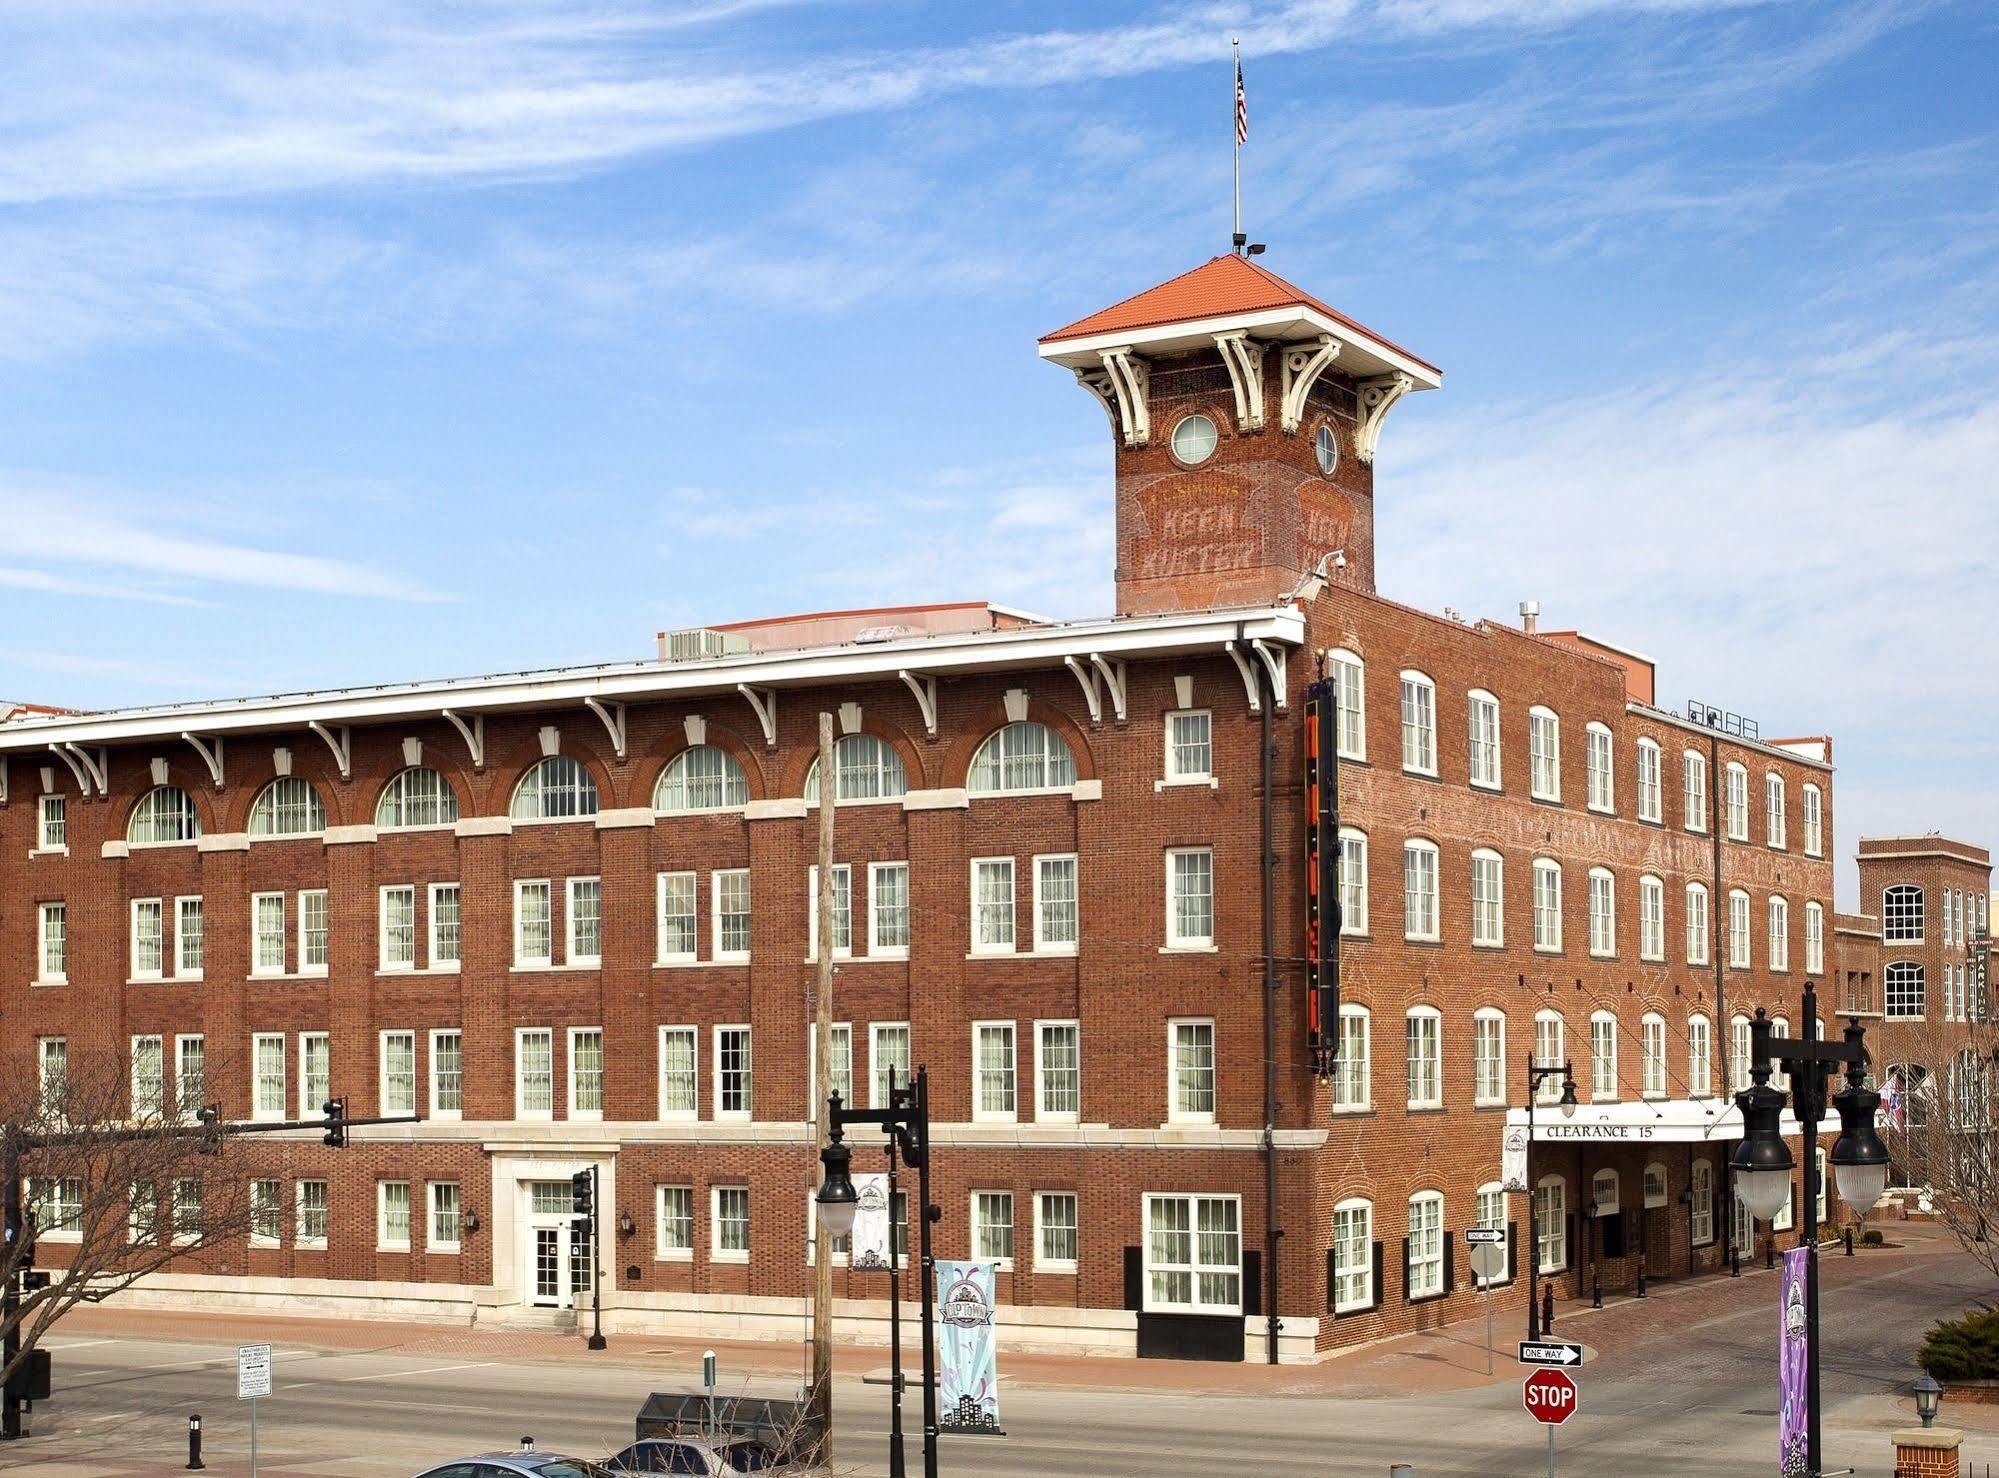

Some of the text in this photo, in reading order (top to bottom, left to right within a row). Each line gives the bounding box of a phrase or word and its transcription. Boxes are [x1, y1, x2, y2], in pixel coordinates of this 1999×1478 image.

[1977, 955, 1985, 1014] PARKING
[1546, 1126, 1629, 1138] CLEARANCE
[1525, 1348, 1563, 1359] ONE WAY
[1528, 1384, 1573, 1407] STOP
